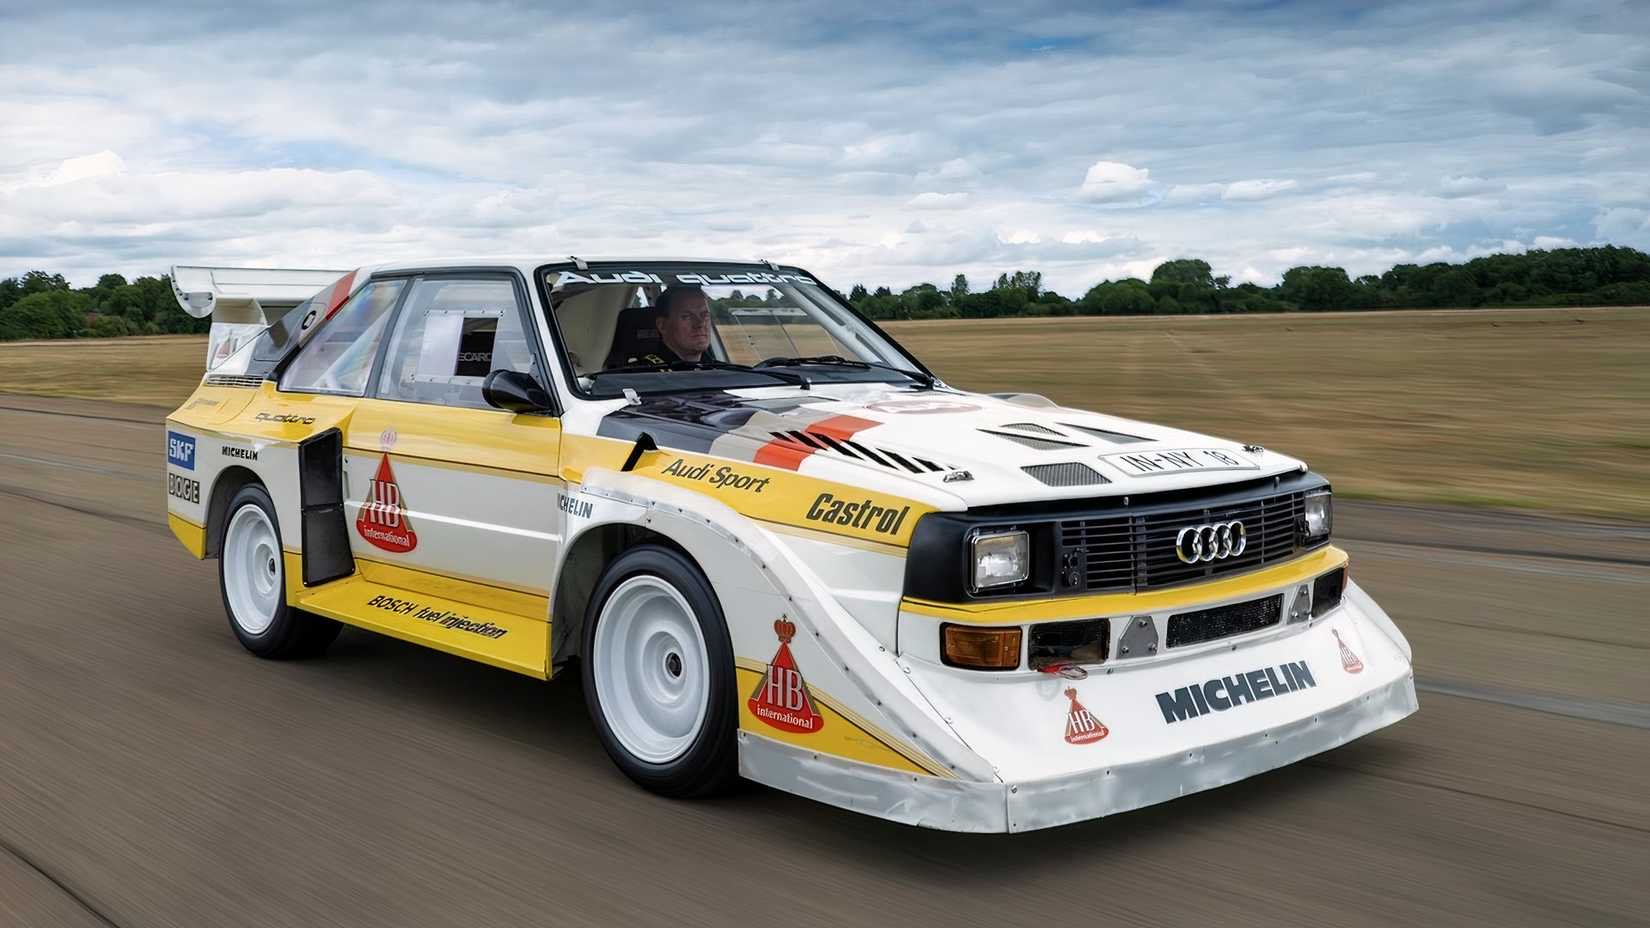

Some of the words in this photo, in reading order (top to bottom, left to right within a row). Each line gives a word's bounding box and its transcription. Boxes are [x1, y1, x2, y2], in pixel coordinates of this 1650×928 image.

[554, 271, 663, 286] Audi
[676, 271, 818, 286] quattro
[256, 412, 316, 425] quattro
[169, 438, 194, 463] SKF
[222, 445, 259, 461] MICHELIN
[169, 473, 201, 504] BOGE
[661, 458, 715, 482] Audi
[710, 466, 770, 493] Sport
[367, 479, 402, 528] HB
[806, 493, 910, 536] Castrol
[364, 527, 410, 547] international
[368, 595, 417, 614] BOSCH
[416, 607, 446, 622] fuel
[442, 611, 507, 640] injection
[766, 664, 804, 711] HB
[1155, 660, 1317, 724] MICHELIN
[756, 704, 814, 729] international
[1068, 709, 1095, 734] HB
